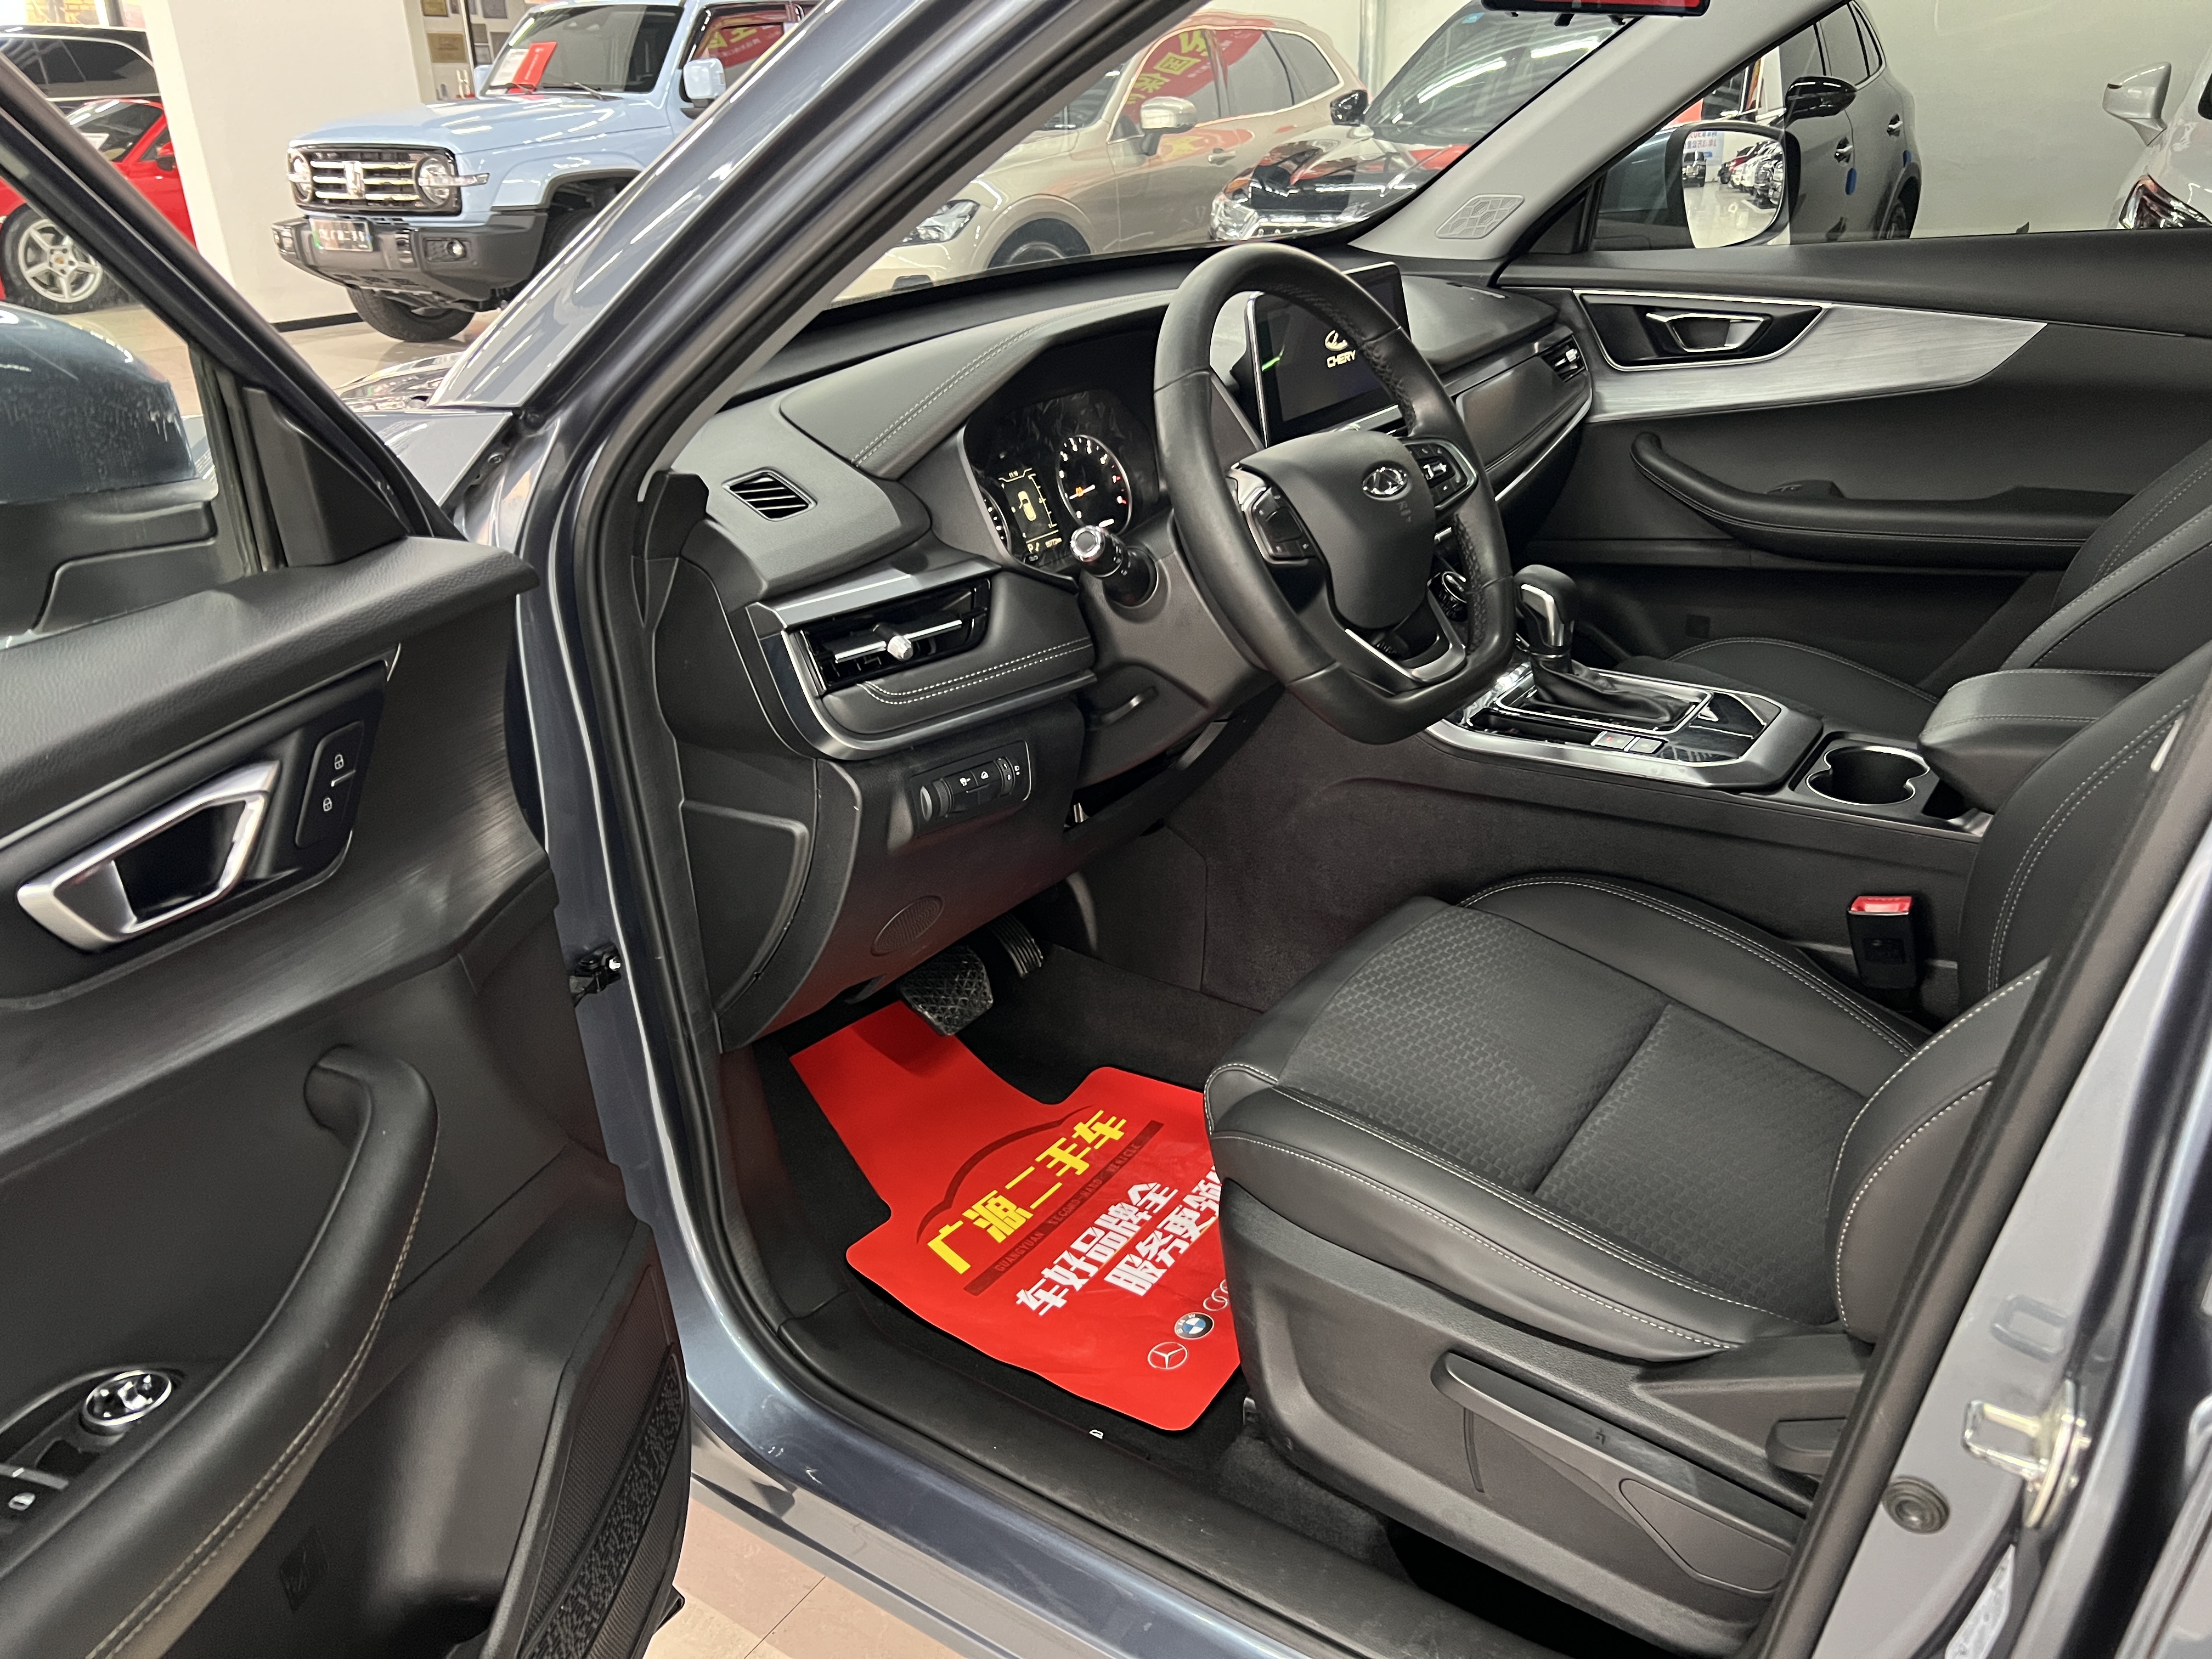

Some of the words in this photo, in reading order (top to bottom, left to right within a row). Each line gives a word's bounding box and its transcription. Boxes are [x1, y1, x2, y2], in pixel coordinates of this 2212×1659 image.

[1327, 349, 1356, 368] CHERY
[927, 1110, 1127, 1274] 广源二手车
[994, 1231, 1045, 1272] GUANGYUAN
[1048, 1178, 1103, 1226] SECOND-HAND
[1105, 1143, 1141, 1173] VEHICLE
[1015, 1182, 1178, 1316] 车好品牌全
